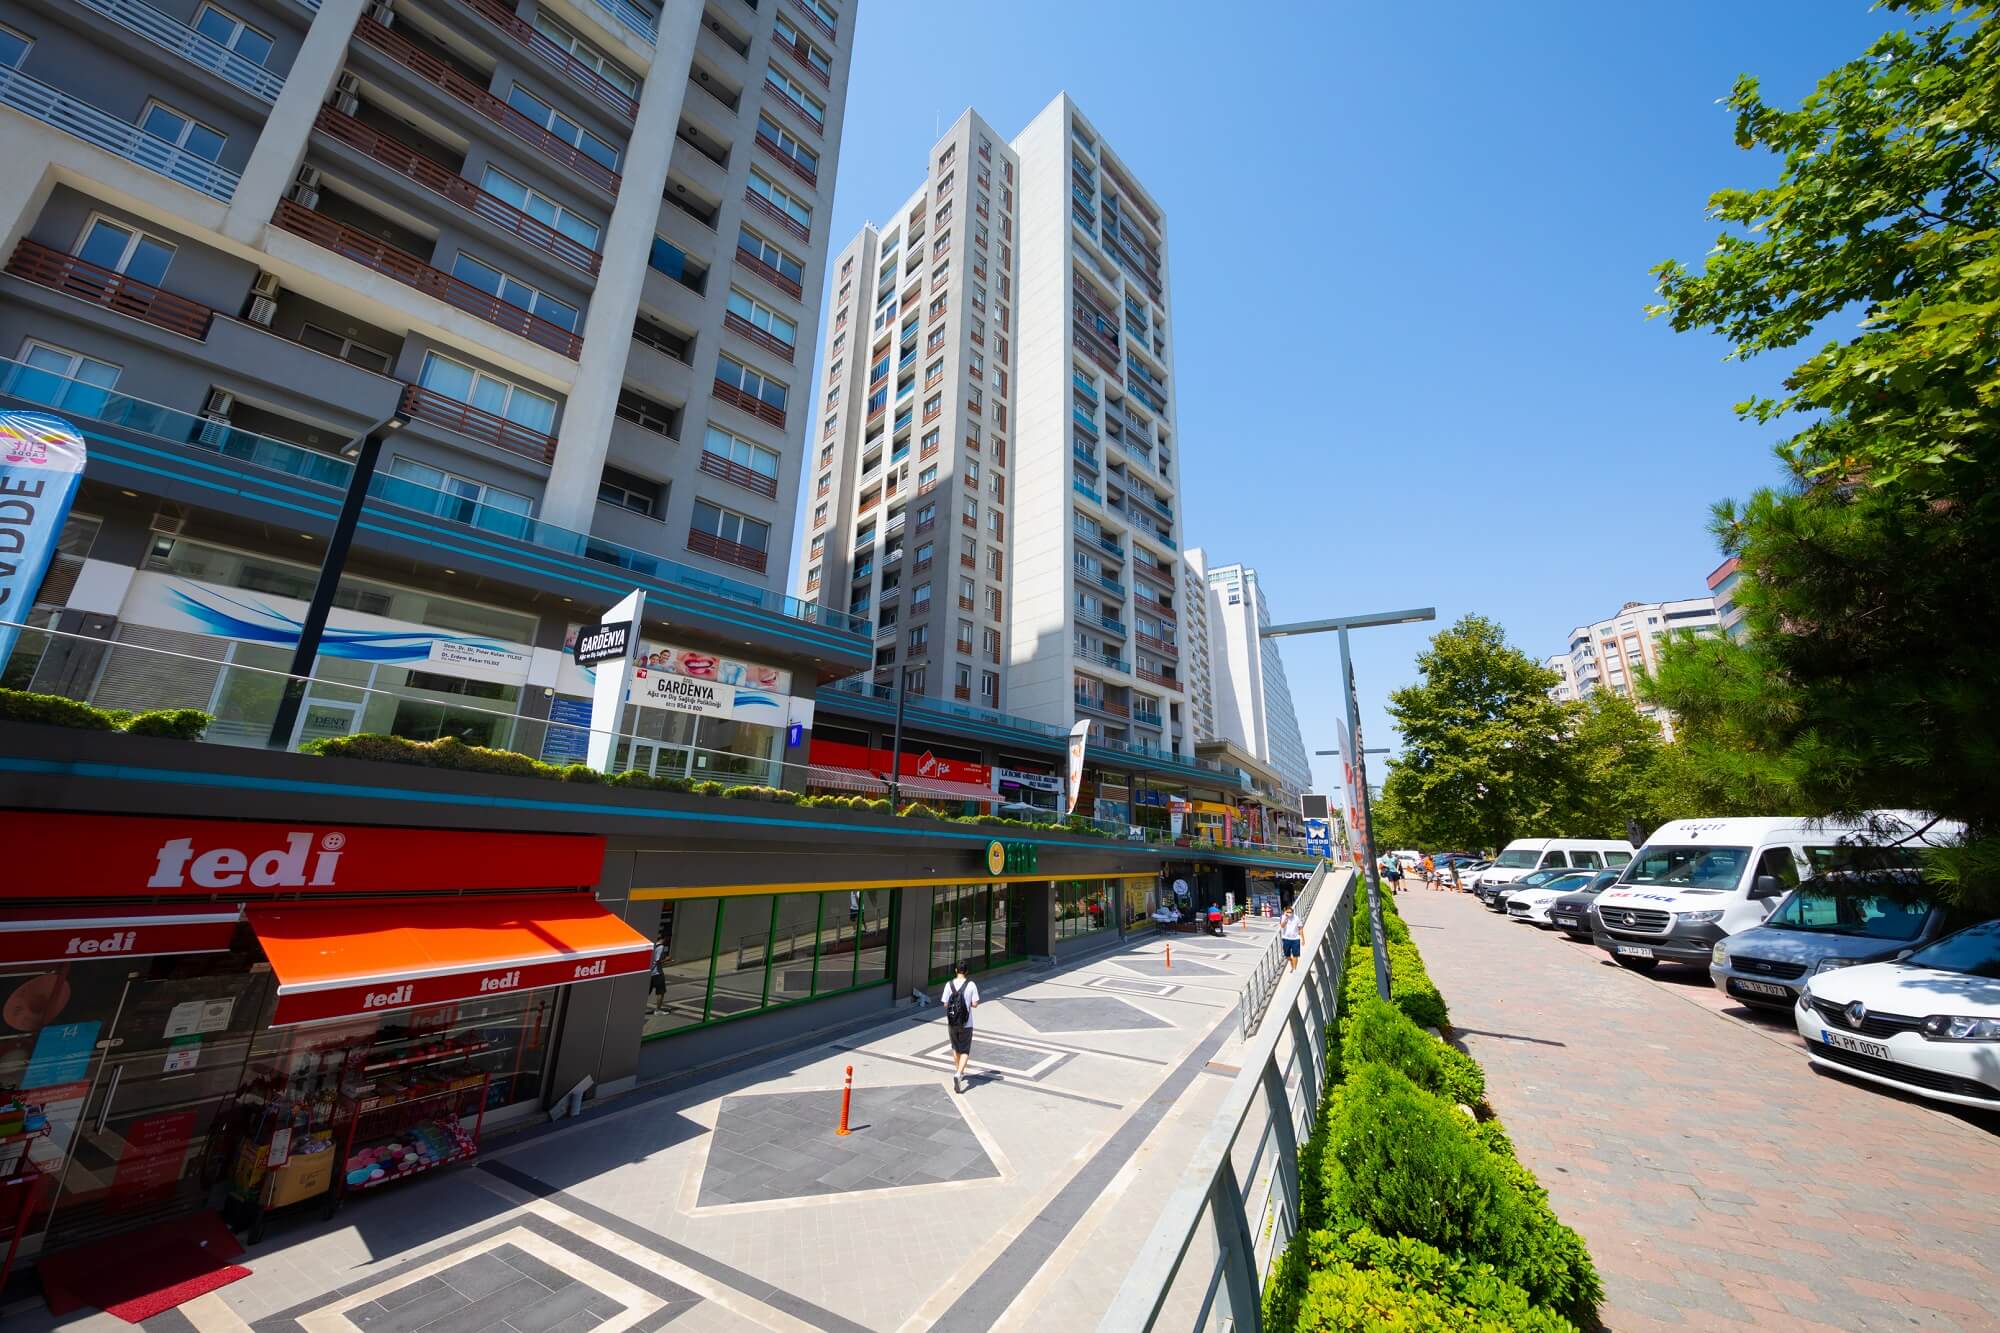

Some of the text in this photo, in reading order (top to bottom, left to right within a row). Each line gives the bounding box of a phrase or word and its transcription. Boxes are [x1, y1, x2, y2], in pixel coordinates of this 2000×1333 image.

[580, 629, 625, 653] GARDENYA
[658, 678, 714, 700] GARDENYA
[147, 832, 346, 888] tedi
[65, 932, 137, 954] tedi
[574, 960, 606, 978] tedi
[480, 972, 520, 991] tedi
[363, 984, 414, 1008] tedi
[1828, 1033, 1888, 1059] 34 PM 0021
